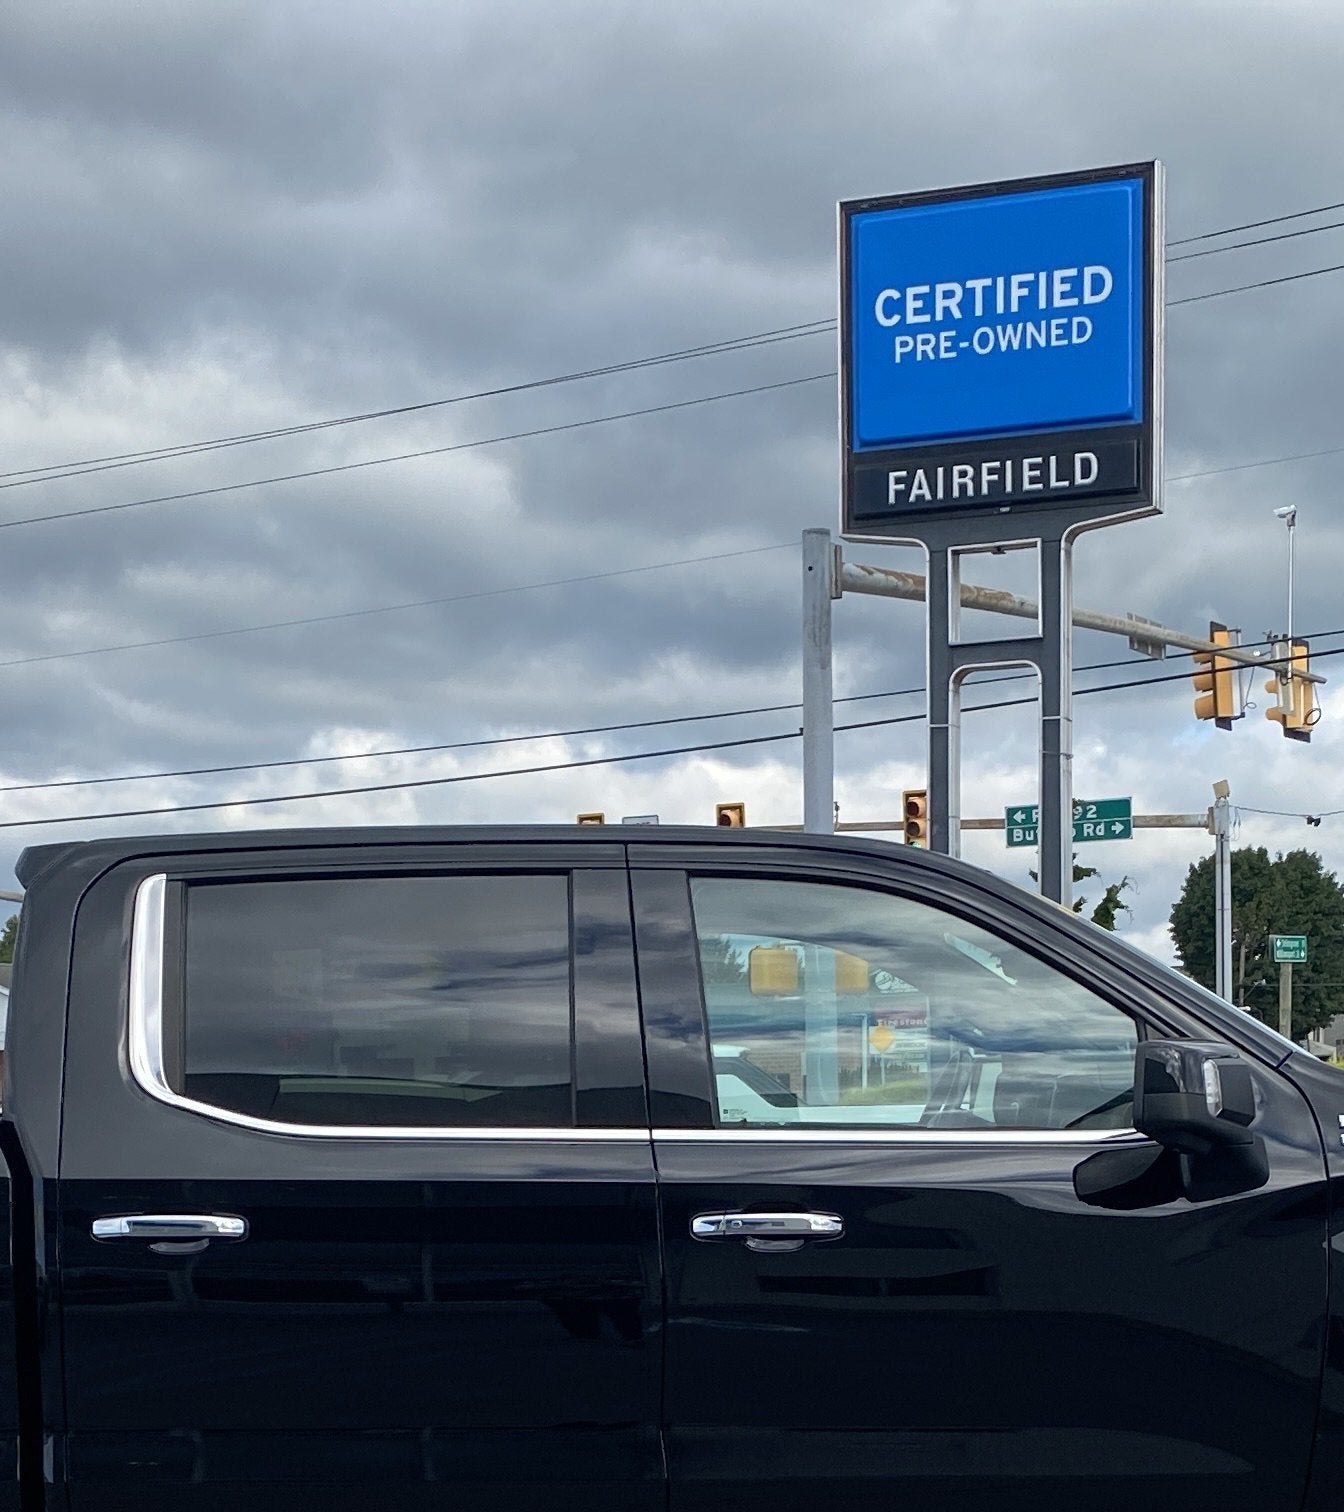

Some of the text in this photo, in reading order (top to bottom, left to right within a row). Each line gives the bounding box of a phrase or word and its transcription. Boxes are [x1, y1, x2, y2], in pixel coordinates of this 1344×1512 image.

[874, 265, 1114, 328] CERTIFIED
[894, 316, 1094, 364] PRE-OWNED
[887, 451, 1099, 505] FAIRFIELD
[1072, 804, 1098, 820] 92
[1083, 822, 1105, 837] Rd
